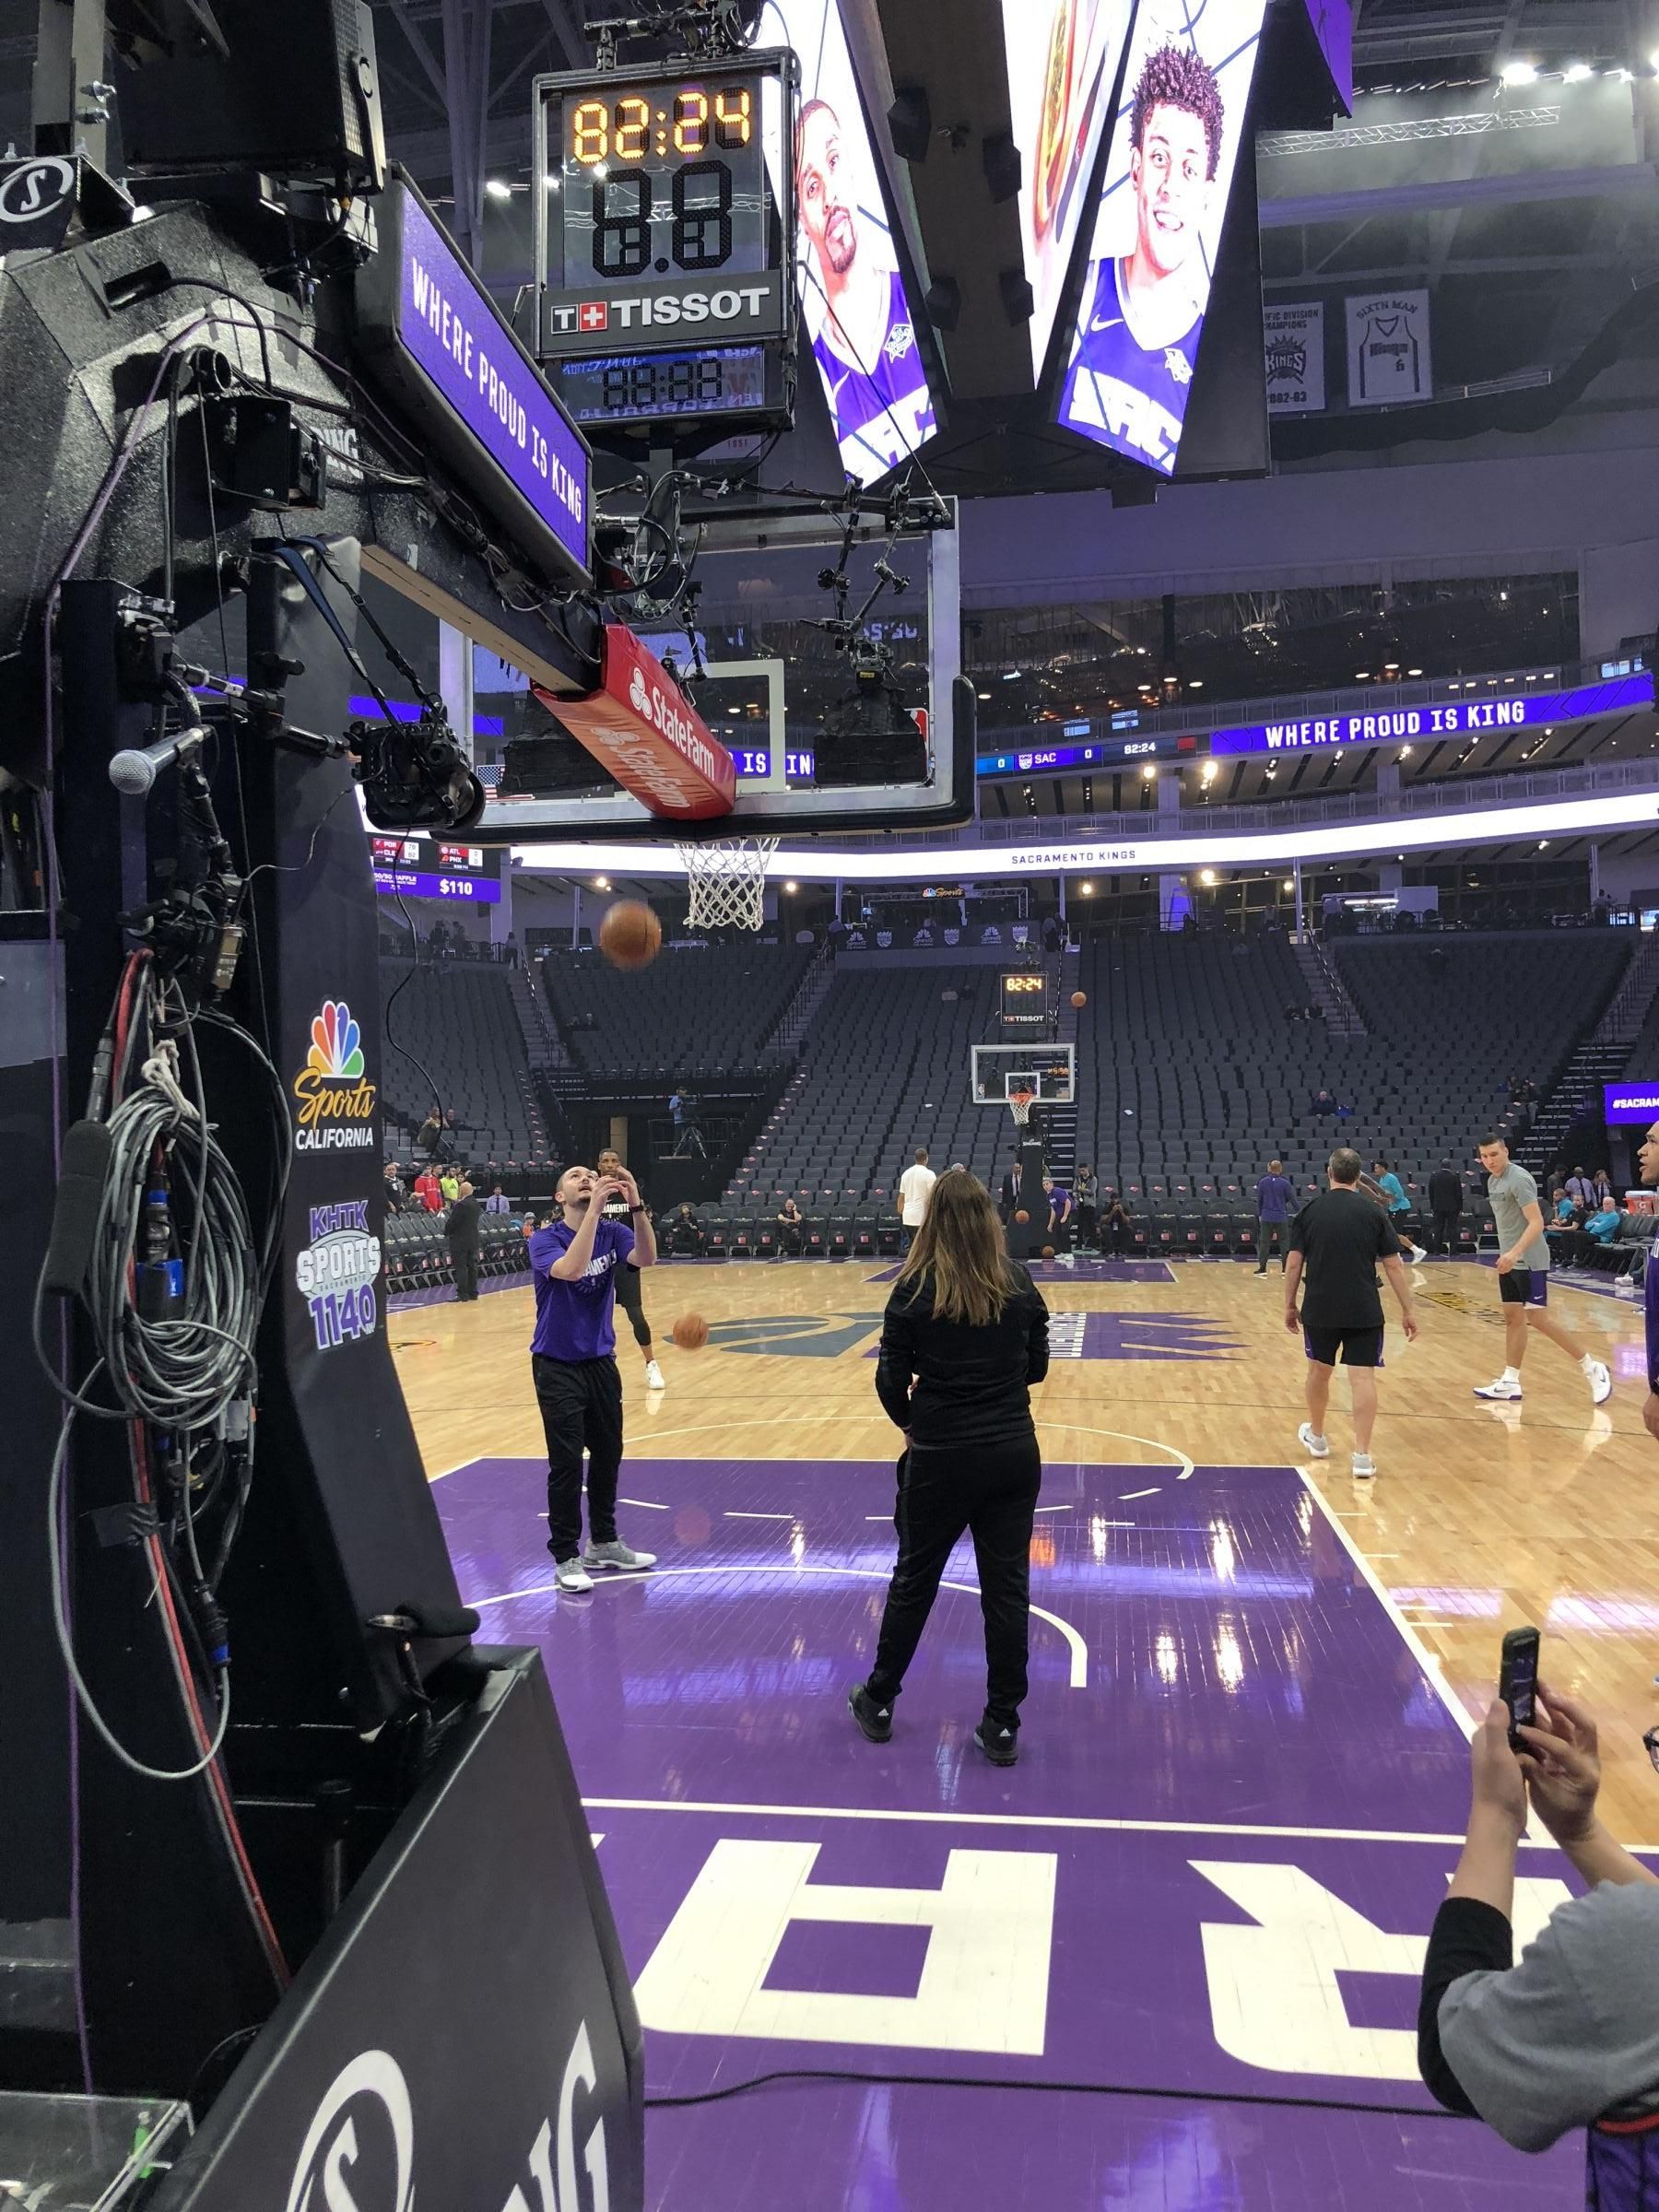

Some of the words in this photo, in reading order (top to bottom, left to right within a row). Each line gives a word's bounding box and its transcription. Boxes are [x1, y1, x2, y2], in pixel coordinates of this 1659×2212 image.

[574, 91, 750, 163] 82:24
[611, 288, 770, 328] TISSOT
[1283, 309, 1319, 319] DIVISION
[1357, 301, 1389, 319] SIXTH
[1392, 300, 1418, 314] MAN
[1265, 320, 1307, 331] HAMPIONS
[1265, 352, 1304, 371] KINGS
[412, 257, 474, 380] WHERE
[479, 351, 526, 449] PROUD
[532, 426, 547, 479] IS
[552, 453, 582, 524] KING
[1265, 720, 1340, 748] WHERE
[1349, 712, 1420, 739] PROUD
[1430, 709, 1458, 731] IS
[1467, 700, 1524, 728] KING
[1034, 753, 1056, 764] SAC
[1084, 748, 1092, 759] 0
[1124, 742, 1156, 755] 82:24
[743, 753, 766, 773] IS
[1011, 852, 1094, 865] SACRAMENTO
[1100, 850, 1136, 861] KINGS
[440, 878, 473, 895] $110
[1006, 978, 1041, 991] 82:24
[295, 1067, 376, 1130] Sports
[295, 1127, 373, 1150] CALIFORNIA
[310, 1200, 370, 1242] KHTK
[297, 1236, 381, 1292] SPORTS
[320, 1275, 367, 1292] SACRAMENTO
[310, 1284, 376, 1349] 1140
